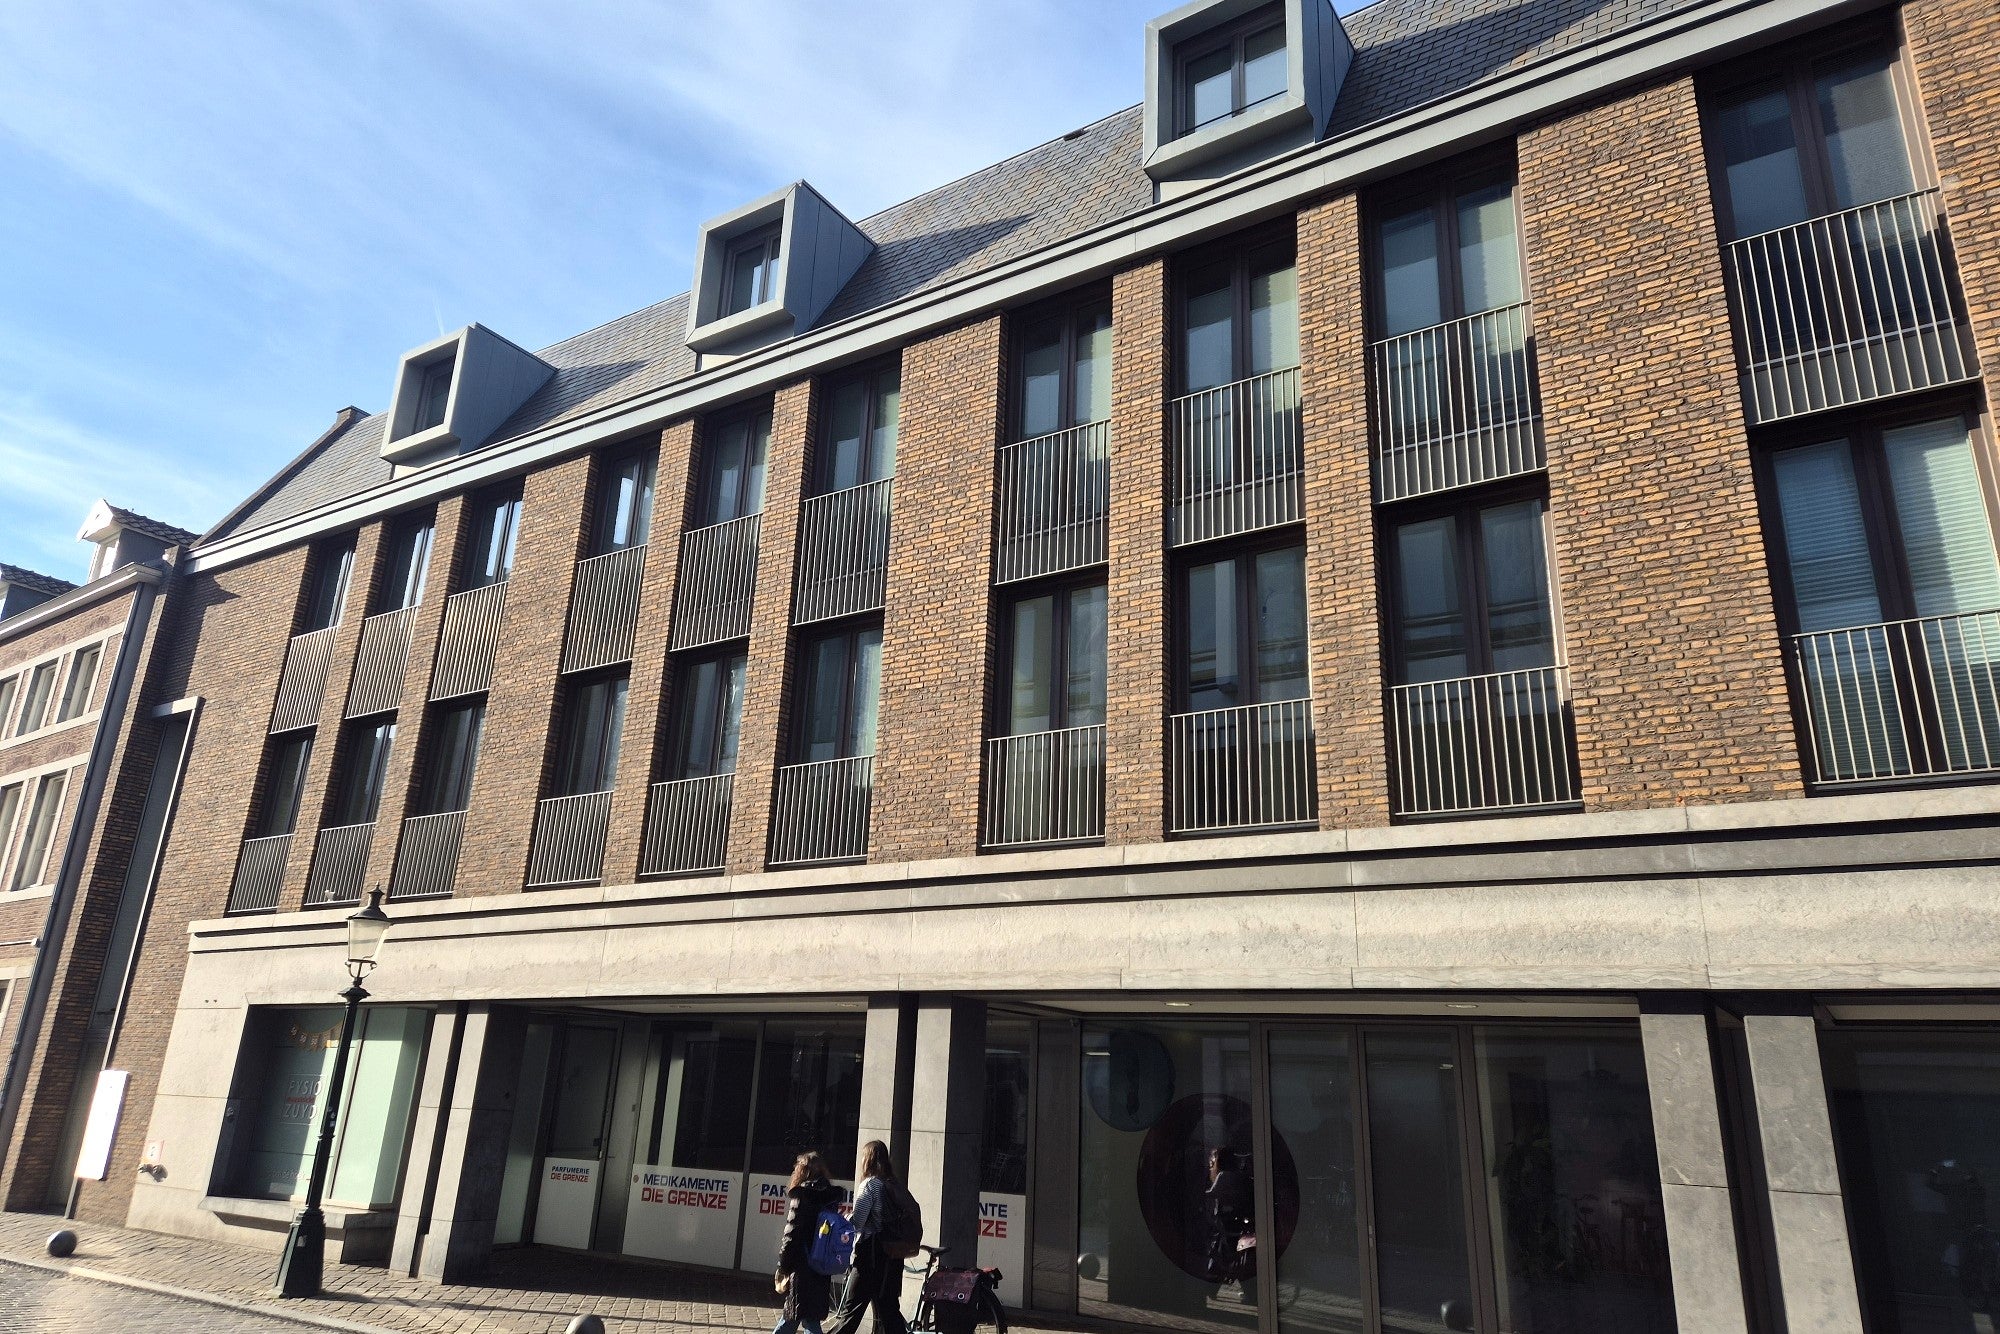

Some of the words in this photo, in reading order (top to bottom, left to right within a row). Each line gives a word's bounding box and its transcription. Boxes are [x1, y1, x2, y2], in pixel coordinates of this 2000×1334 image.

[550, 1172, 562, 1181] DIE
[562, 1173, 588, 1184] GRENZE
[551, 1165, 590, 1176] PARFUMERIE
[643, 1173, 730, 1193] MEDIKAMENTE
[641, 1187, 665, 1204] DIE
[667, 1189, 728, 1211] GRENZE
[759, 1198, 786, 1216] DIE
